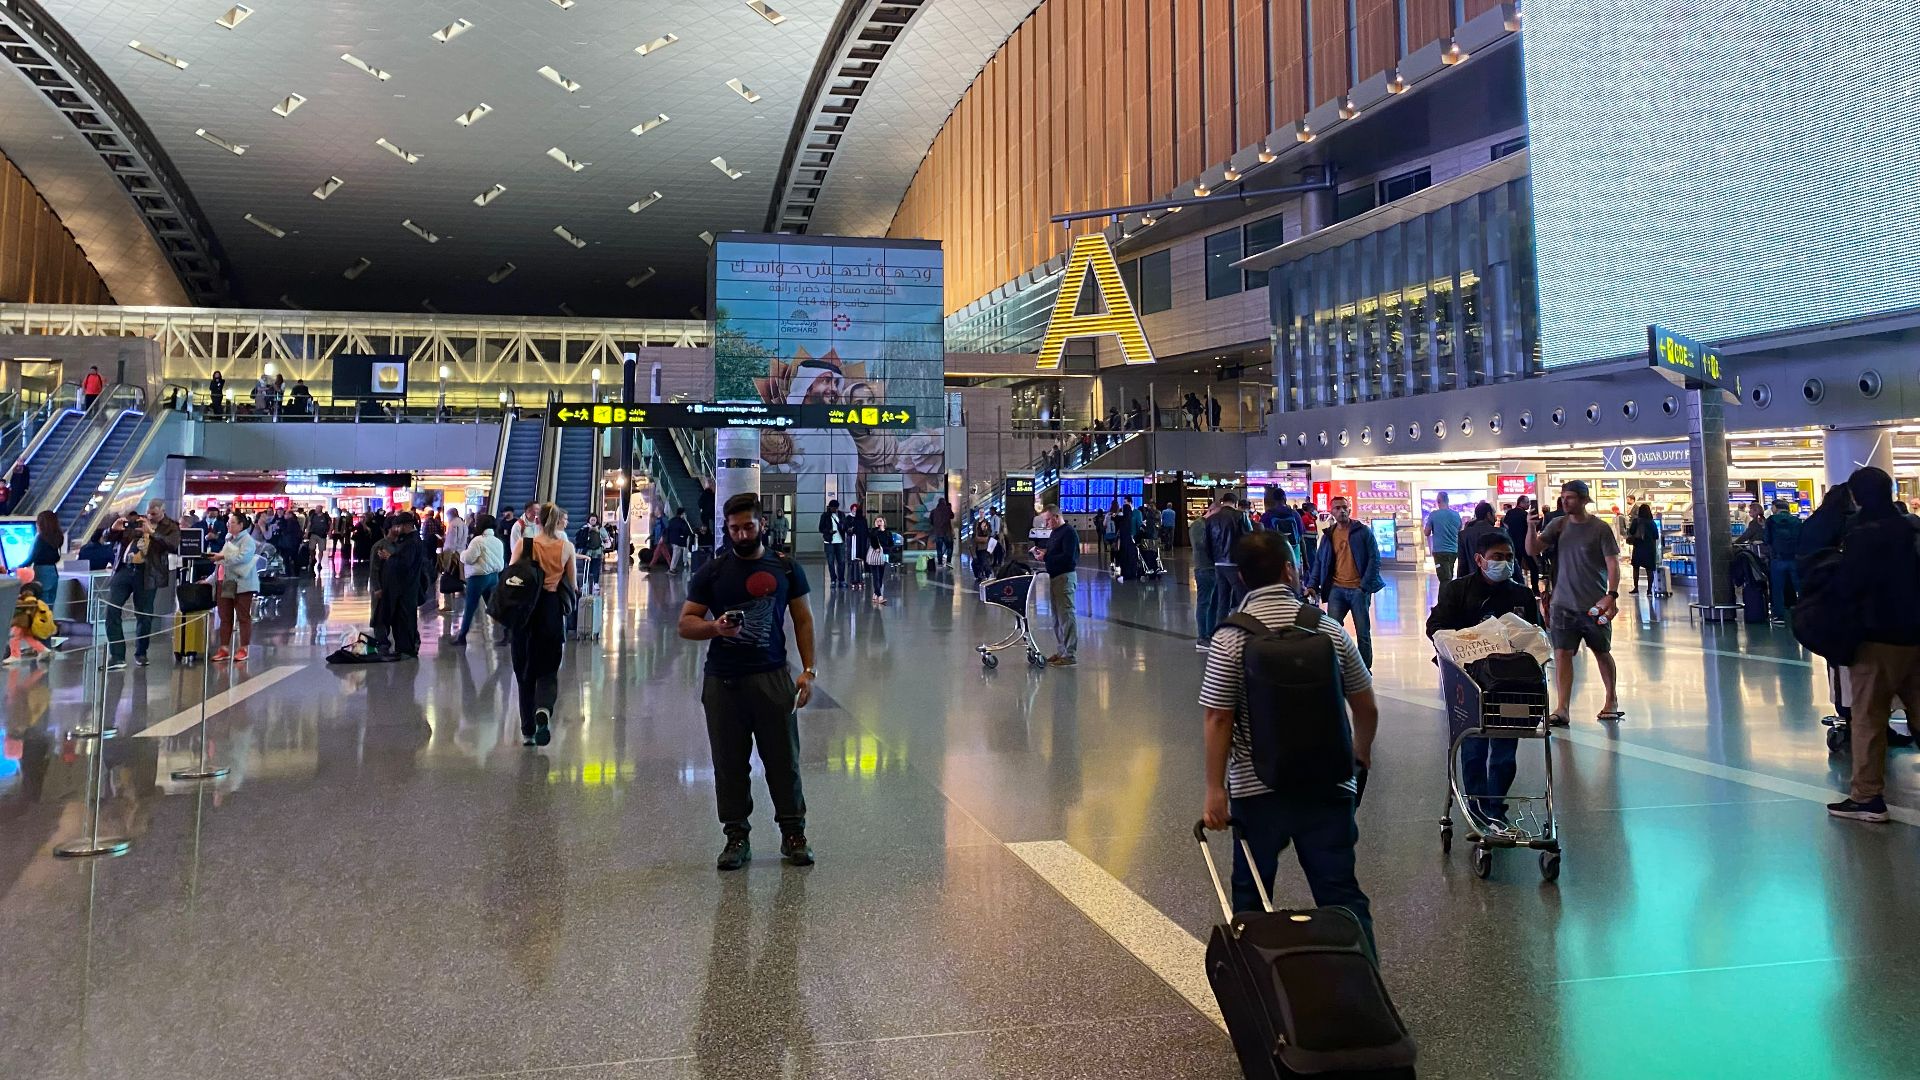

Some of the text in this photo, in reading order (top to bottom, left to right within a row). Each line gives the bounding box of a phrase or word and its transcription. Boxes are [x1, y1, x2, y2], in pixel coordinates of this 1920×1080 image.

[1036, 233, 1155, 369] A
[614, 408, 627, 422] B
[847, 409, 859, 424] A
[1638, 451, 1662, 462] QATAR
[1662, 450, 1684, 460] DUTY
[1453, 648, 1477, 660] DUTY
[1478, 643, 1500, 654] FREE
[1455, 638, 1492, 653] QATAR
